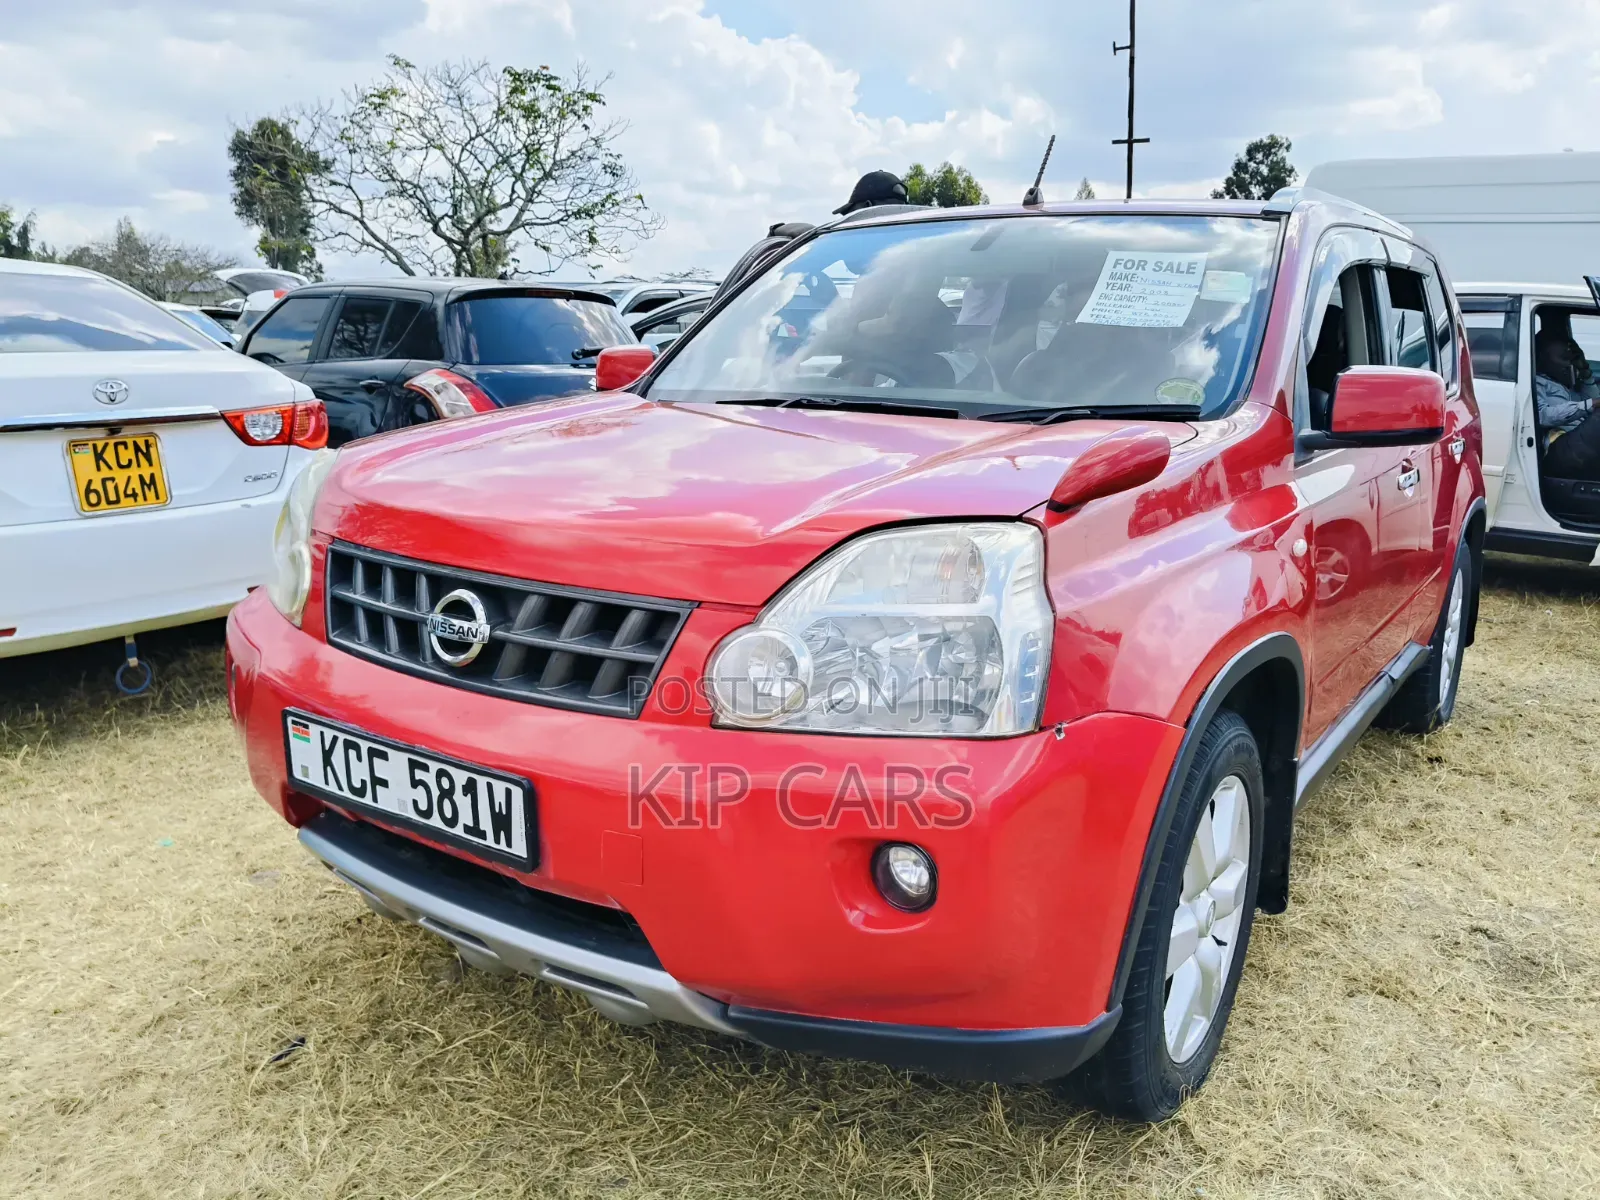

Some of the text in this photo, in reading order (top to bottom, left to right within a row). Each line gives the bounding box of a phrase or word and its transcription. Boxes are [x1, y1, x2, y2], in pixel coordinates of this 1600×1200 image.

[1112, 258, 1198, 275] FOR SALE
[1108, 271, 1139, 283] MAKE:
[1105, 282, 1133, 293] YEAR:
[1098, 292, 1113, 301] ENG
[1113, 293, 1148, 304] CAPACITY:
[1091, 307, 1123, 315] PRICE:
[91, 438, 155, 473] KCN
[83, 471, 161, 508] 604M
[428, 618, 479, 640] NISSAN
[319, 730, 390, 804] KCF
[407, 757, 513, 849] 581W
